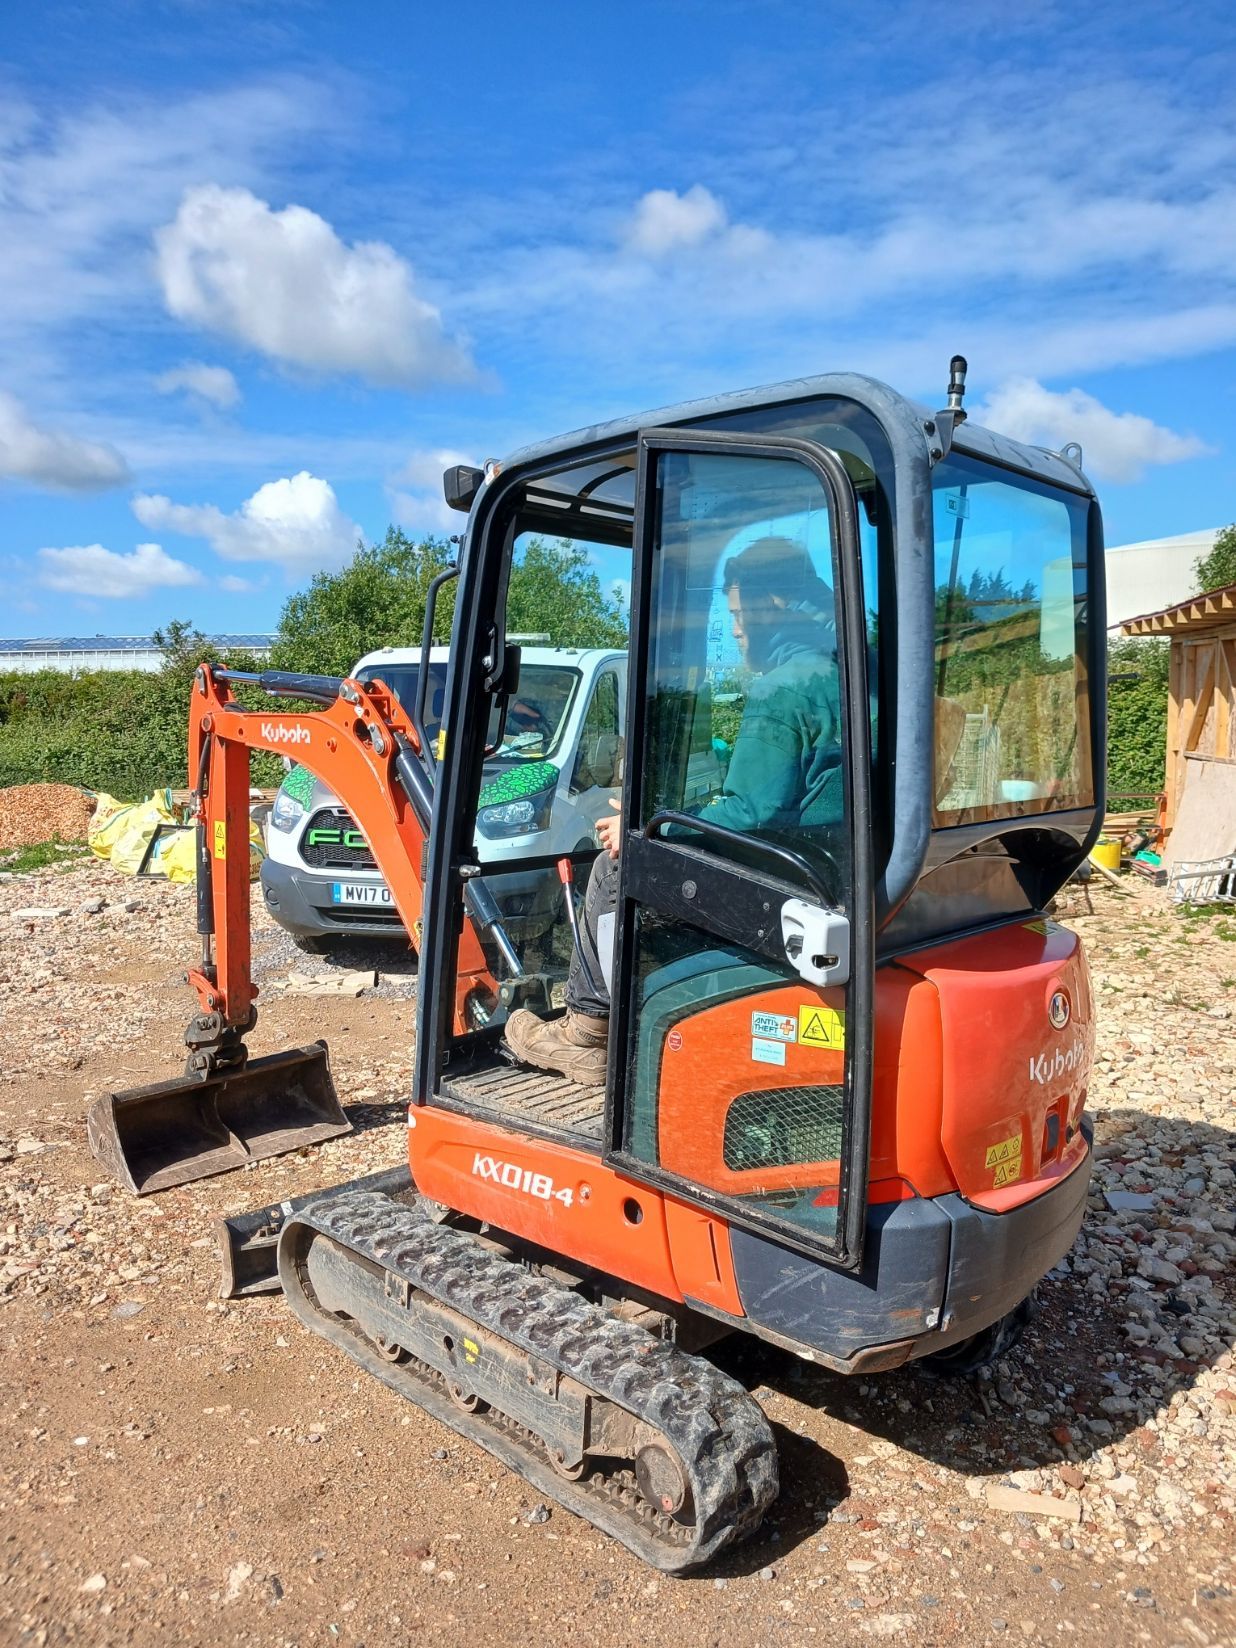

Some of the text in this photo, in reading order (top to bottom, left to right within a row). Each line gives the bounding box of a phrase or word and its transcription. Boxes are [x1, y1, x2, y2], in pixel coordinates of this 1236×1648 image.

[261, 722, 311, 744] Kubota
[346, 886, 377, 902] MV17
[754, 1024, 778, 1034] THEFT
[472, 1152, 574, 1208] KX018-4
